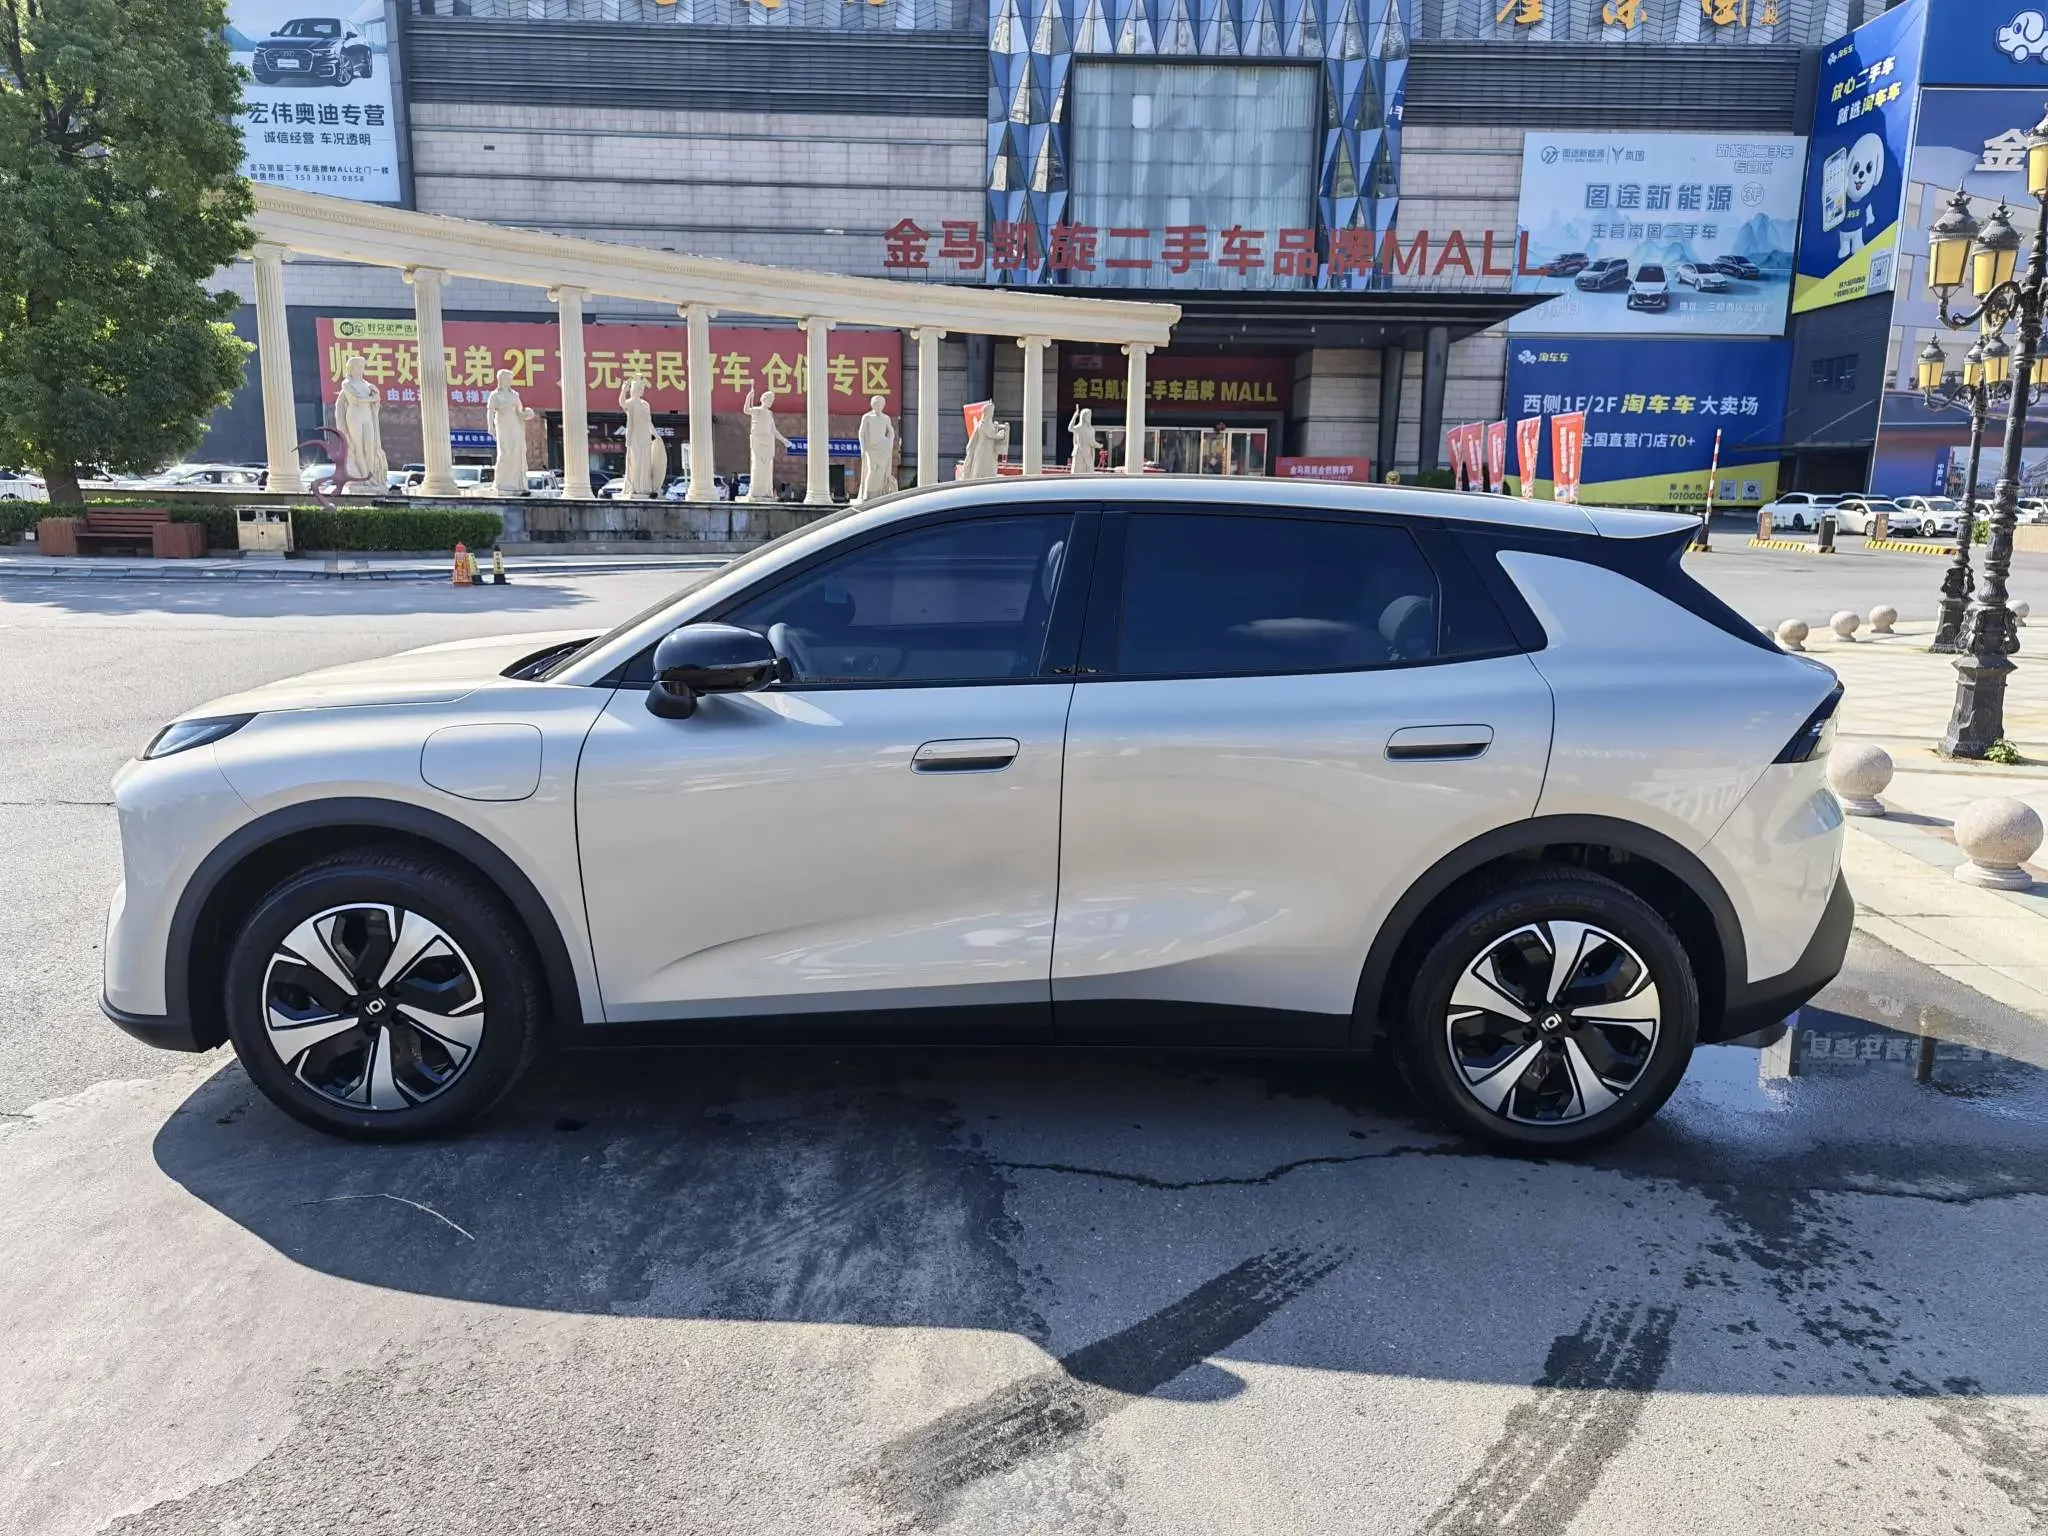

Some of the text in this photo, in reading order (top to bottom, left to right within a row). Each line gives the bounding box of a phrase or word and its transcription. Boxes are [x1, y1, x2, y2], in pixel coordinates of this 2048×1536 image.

[1831, 56, 1896, 103] 放心二手车
[249, 102, 385, 126] 宏伟奥迪专营
[1836, 81, 1902, 126] 就选淘车车
[264, 131, 372, 146] 诚信经营 车况透明
[1585, 183, 1733, 211] 图途新能源
[1592, 223, 1718, 240] 主营岚图二手车
[884, 217, 1550, 278] 金马凯旋二手车品牌MALL
[1538, 352, 1569, 363] 淘车车
[504, 348, 545, 387] 2F
[556, 349, 751, 393] 元亲民车
[1221, 382, 1277, 401] MALL
[1523, 394, 1758, 416] 西侧1F/2F 淘车车 大卖场
[1582, 432, 1696, 448] 全国直营门店70+
